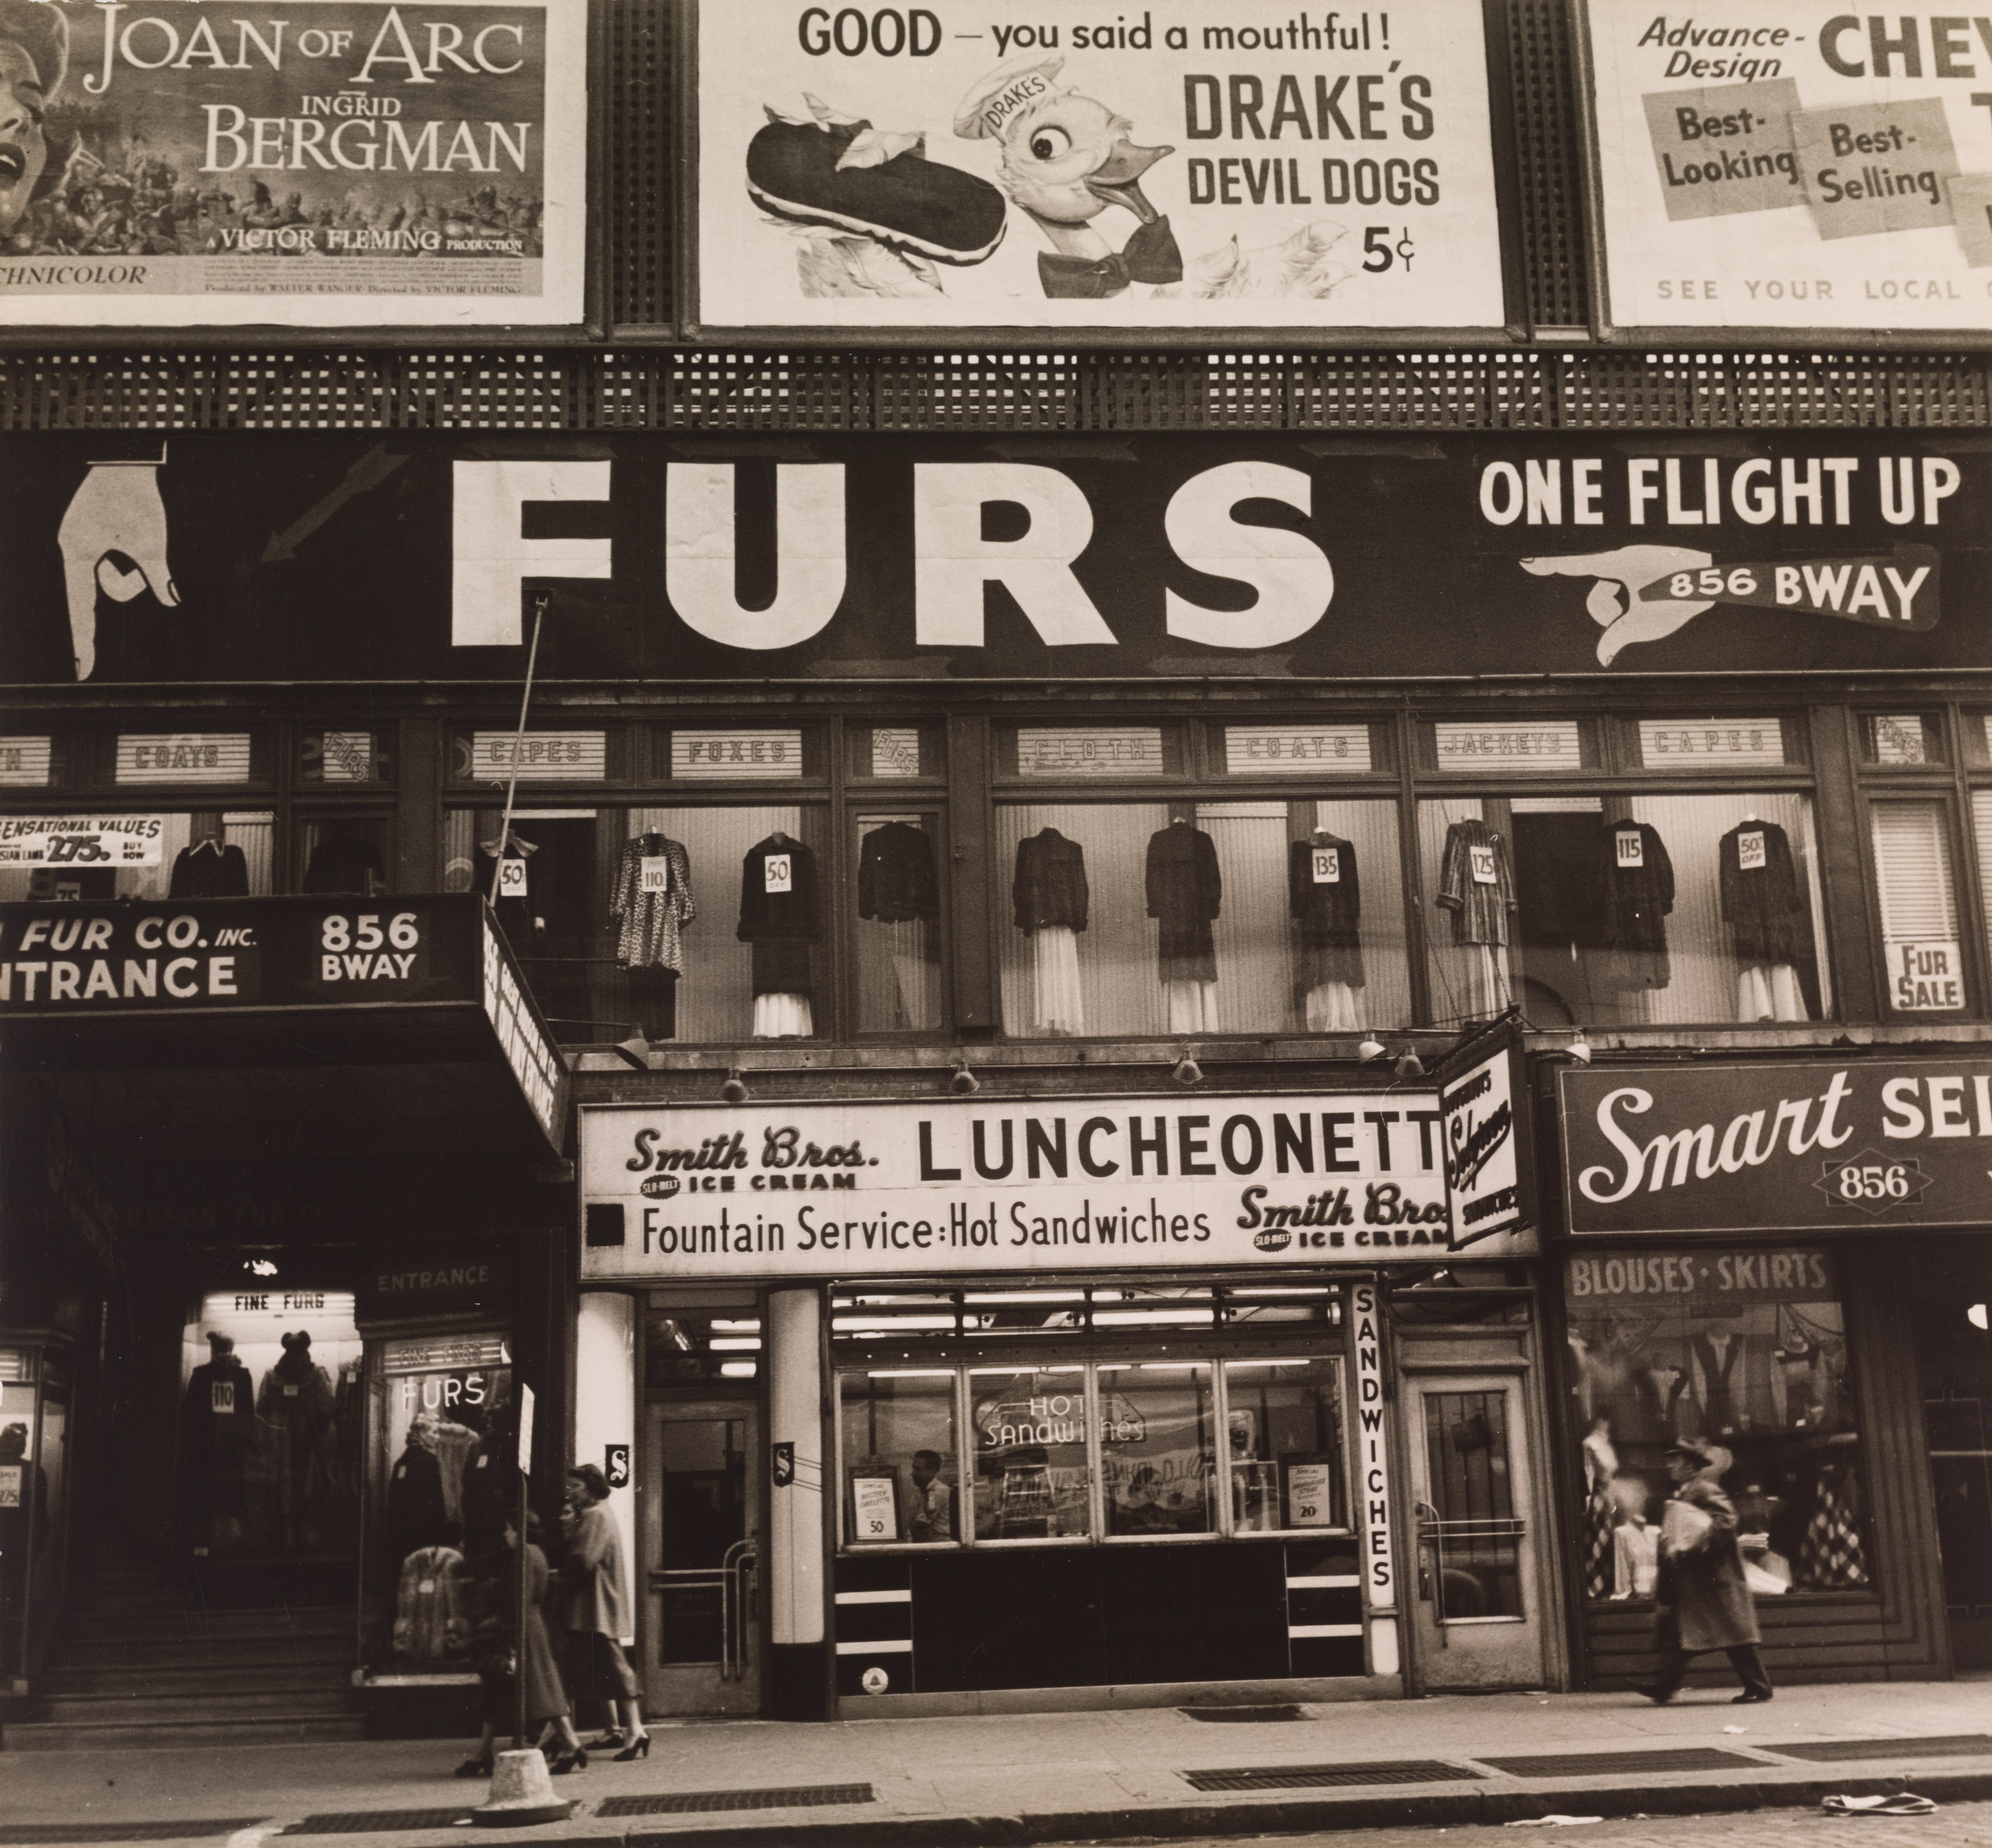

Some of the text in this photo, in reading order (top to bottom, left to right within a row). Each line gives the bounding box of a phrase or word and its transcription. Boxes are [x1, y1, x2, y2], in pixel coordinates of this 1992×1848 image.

[799, 7, 942, 57] GOOD
[992, 25, 1059, 57] you
[1072, 11, 1152, 50] said
[1164, 26, 1188, 49] a
[1637, 16, 1806, 48] Advance-
[83, 4, 524, 94] JOAN OF ARC
[1664, 50, 1782, 83] Design
[300, 95, 401, 118] INGRID
[986, 76, 1047, 129] DRAKE'S
[1184, 60, 1435, 141] DRAKE'S
[201, 104, 531, 172] BERGMAN
[1675, 106, 1766, 141] Best-
[1829, 123, 1916, 157] Best-
[1187, 158, 1440, 206] DEVIL DOGS
[1662, 149, 1800, 187] Looking
[1817, 166, 1941, 205] Selling
[207, 229, 523, 250] A VICTOR FLEMING PRODUCTION
[1362, 227, 1415, 273] 5¢
[205, 284, 250, 292] Produced
[254, 284, 265, 293] by
[269, 284, 313, 292] WALTER
[368, 285, 407, 294] Directed
[411, 285, 421, 294] by
[426, 285, 467, 294] VICTOR
[470, 285, 522, 294] FLEMING
[1657, 280, 1961, 300] SEE YOUR LOCAL
[1479, 457, 1961, 525] ONE FLIGHT UP
[451, 460, 1335, 649] FURS
[1669, 564, 1931, 620] 856 BWAY
[135, 744, 219, 768] COATS
[325, 733, 370, 781] FURS
[490, 740, 581, 762] CAPES
[689, 740, 786, 762] FOXES
[874, 730, 919, 776] FURS
[1035, 739, 1146, 761] CLOTH
[1246, 737, 1350, 758] COATS
[1444, 733, 1561, 755] JACKETS
[1654, 730, 1764, 752] CAPES
[0, 820, 161, 840] ENSATIONAL VALUES
[1473, 854, 1494, 875] 125
[1618, 839, 1640, 859] 115
[1742, 854, 1762, 864] OFF
[766, 861, 788, 881] 50
[1316, 856, 1338, 875] 135
[19, 919, 113, 951] FUR
[135, 915, 208, 949] CO.
[215, 929, 257, 947] INC.
[322, 913, 419, 952] 856
[322, 954, 417, 981] BWAY
[1902, 945, 1948, 976] FUR
[1898, 976, 1959, 1008] SALE
[626, 1125, 879, 1171] Smith Bros.
[1578, 1071, 1853, 1204] Smart
[690, 1175, 736, 1192] ICE
[750, 1173, 856, 1190] CREAM
[1840, 1165, 1909, 1199] 856
[1237, 1185, 1354, 1229] Smith
[643, 1207, 784, 1254] Fountain
[1009, 1197, 1211, 1246] Sandwiches
[1299, 1232, 1345, 1247] ICE
[377, 1265, 489, 1292] ENTRANCE
[1571, 1253, 1827, 1296] BLOUSES SKIRTS
[235, 1294, 325, 1311] FINE FURS
[402, 1377, 485, 1411] FURS
[1030, 1395, 1084, 1416] HOT
[1356, 1288, 1390, 1587] SANDWICHES
[611, 1450, 627, 1482] S
[774, 1450, 790, 1482] S
[871, 1521, 884, 1533] 50
[1300, 1505, 1317, 1517] 20
